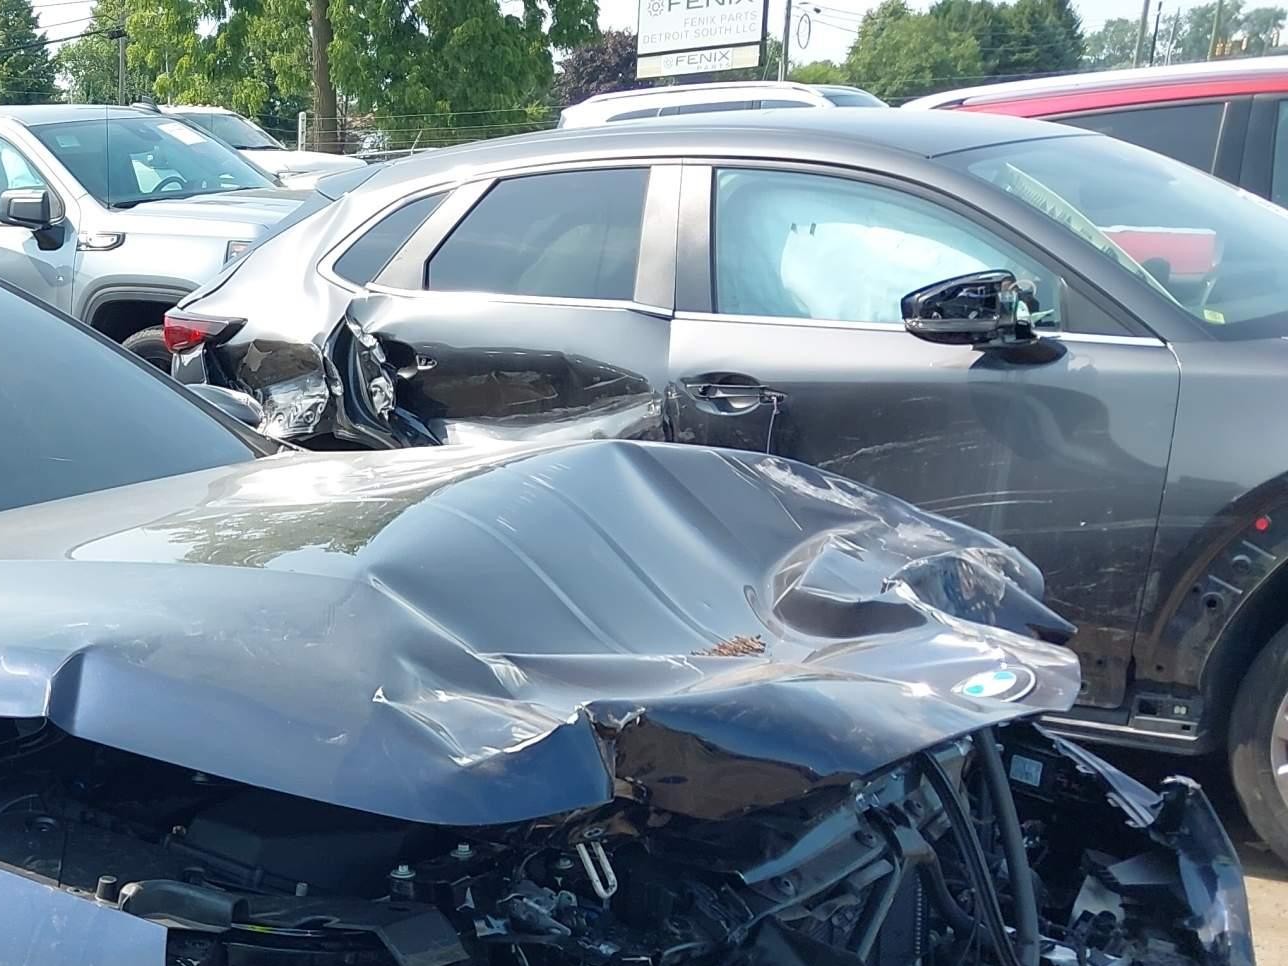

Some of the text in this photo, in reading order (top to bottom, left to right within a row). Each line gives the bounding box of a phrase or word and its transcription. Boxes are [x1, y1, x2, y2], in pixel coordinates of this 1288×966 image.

[684, 10, 758, 27] FENIX PARTS
[642, 22, 757, 44] DETROIT SOUTH LLC
[675, 50, 730, 66] FENIX
